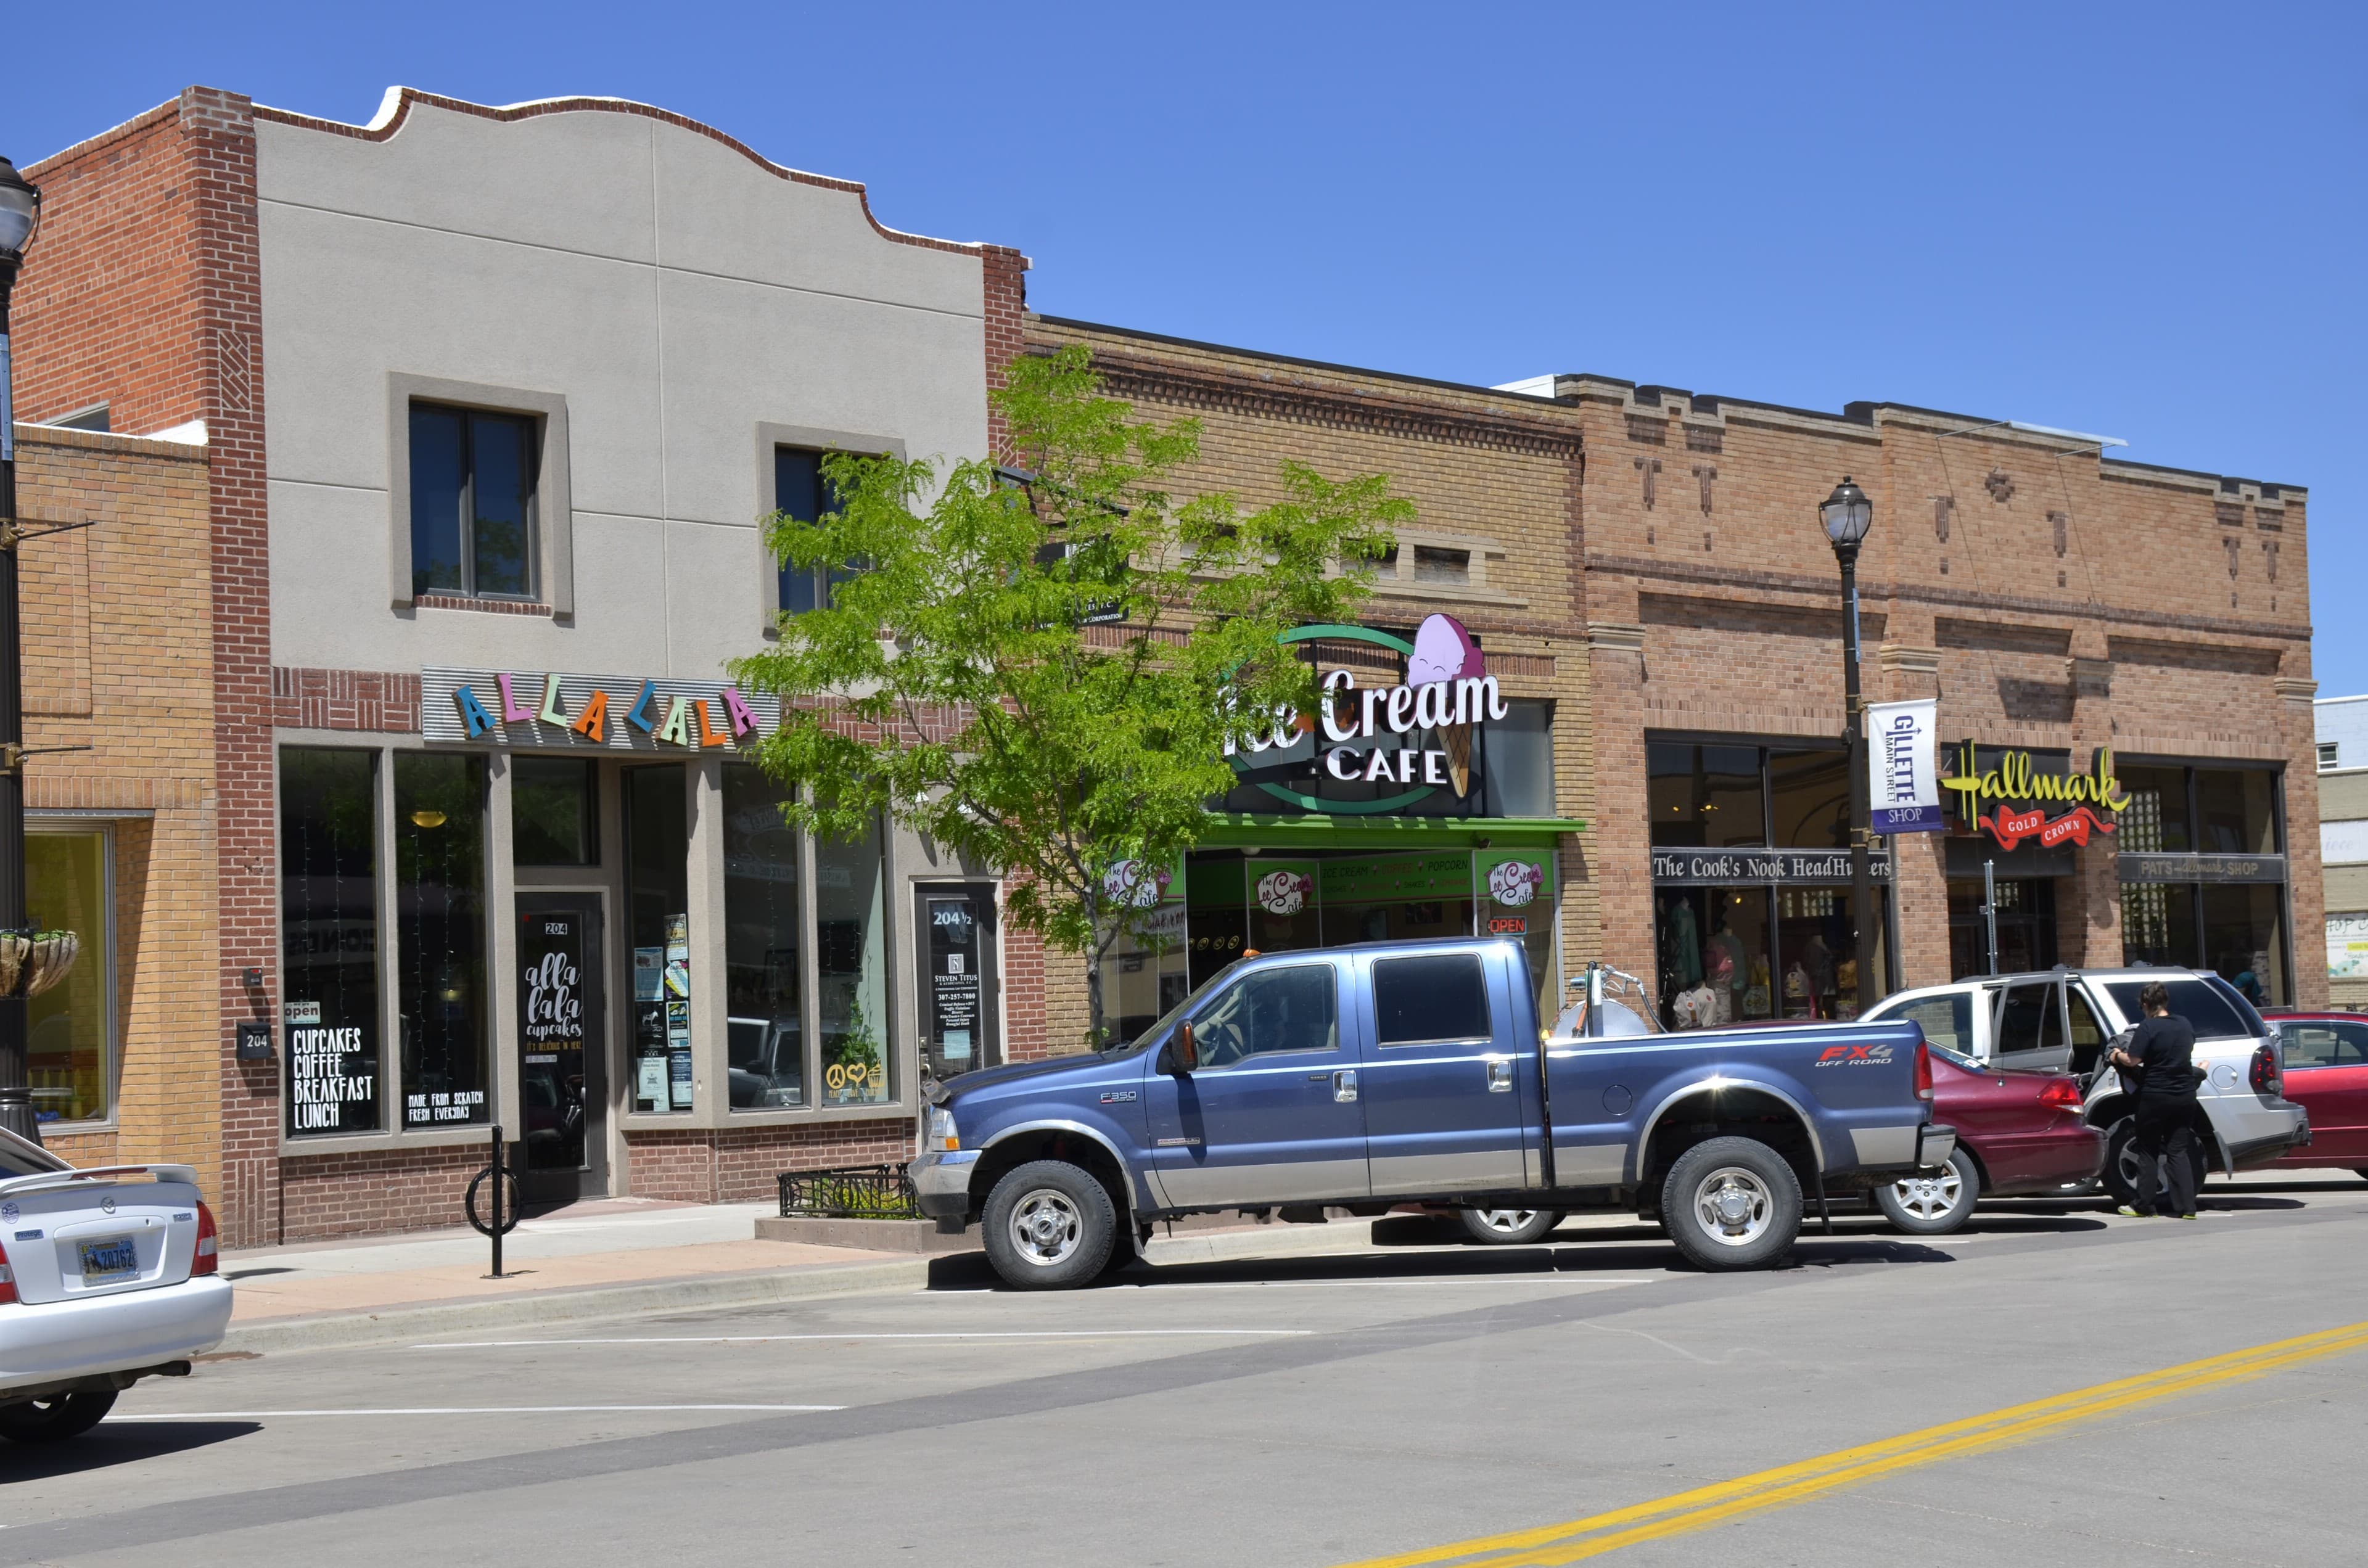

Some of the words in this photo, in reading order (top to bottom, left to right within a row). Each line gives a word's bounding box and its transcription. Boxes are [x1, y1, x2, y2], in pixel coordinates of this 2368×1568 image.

[1318, 669, 1508, 742] Cream
[1886, 737, 1894, 763] MAIN
[1887, 715, 1918, 803] GILLETTE
[1325, 745, 1447, 784] CAFE
[1886, 767, 1896, 803] STREET
[1941, 739, 2132, 831] Hallmark
[1888, 807, 1923, 823] SHOP
[2008, 817, 2038, 832] GOLD
[2044, 819, 2081, 841] CROWN
[1322, 868, 1337, 879] ICE
[1340, 866, 1368, 877] CREAM
[1428, 860, 1468, 872] POPCORN
[1490, 863, 1503, 877] The
[1504, 863, 1540, 889] Cream
[1654, 855, 1685, 877] The
[1692, 856, 1741, 877] Cook's
[1747, 858, 1786, 877] Nook
[1792, 856, 1890, 877] HeadHuers
[2140, 860, 2173, 875] PAT'S
[2227, 862, 2258, 876] SHOP
[1259, 874, 1272, 886] The
[1273, 872, 1312, 898] Cream
[1268, 897, 1303, 914] Cafe
[1499, 888, 1534, 907] Cafe
[546, 924, 567, 934] 204
[934, 911, 960, 925] 204
[1490, 919, 1524, 932] OPEN
[525, 952, 581, 990] alla
[284, 1007, 318, 1019] open
[527, 985, 583, 1024] lala
[527, 1016, 583, 1041] cupcakes
[247, 1035, 268, 1047] 204
[294, 1028, 361, 1054] CUPCAKES
[1819, 1045, 1893, 1061] FX4
[1848, 1057, 1893, 1065] ROAD
[294, 1053, 342, 1079] COFFEE
[294, 1076, 372, 1104] BREAKFAST
[408, 1094, 427, 1108] MADE
[431, 1093, 450, 1106] FROM
[454, 1091, 483, 1105] SCRATCH
[294, 1102, 339, 1129] LUNCH
[409, 1108, 430, 1122] FRESH
[435, 1106, 469, 1120] EVERYDAY
